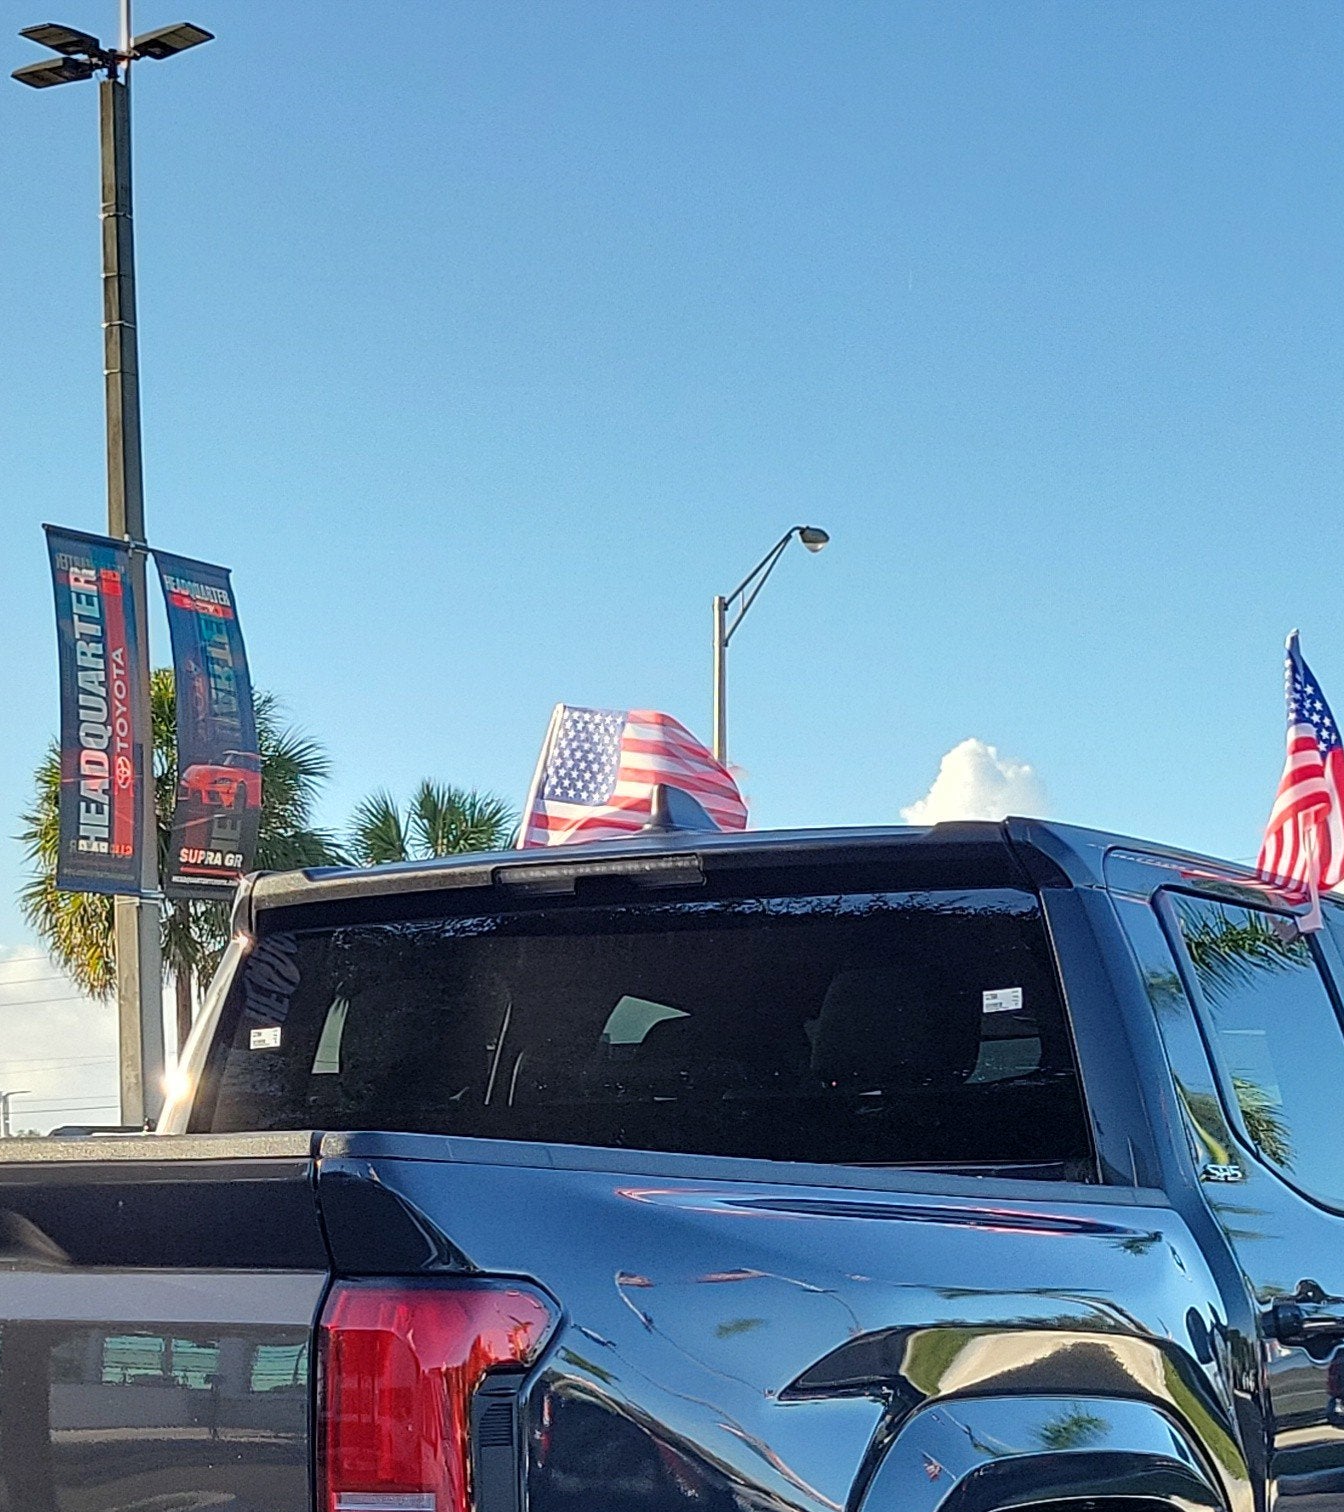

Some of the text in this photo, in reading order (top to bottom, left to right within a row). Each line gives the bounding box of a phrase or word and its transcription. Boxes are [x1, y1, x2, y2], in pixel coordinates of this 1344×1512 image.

[163, 574, 231, 607] HEADQUARTER
[69, 566, 114, 853] HEADQUARTER
[111, 647, 130, 752] TOYOTA
[179, 847, 244, 868] SUPRA GR
